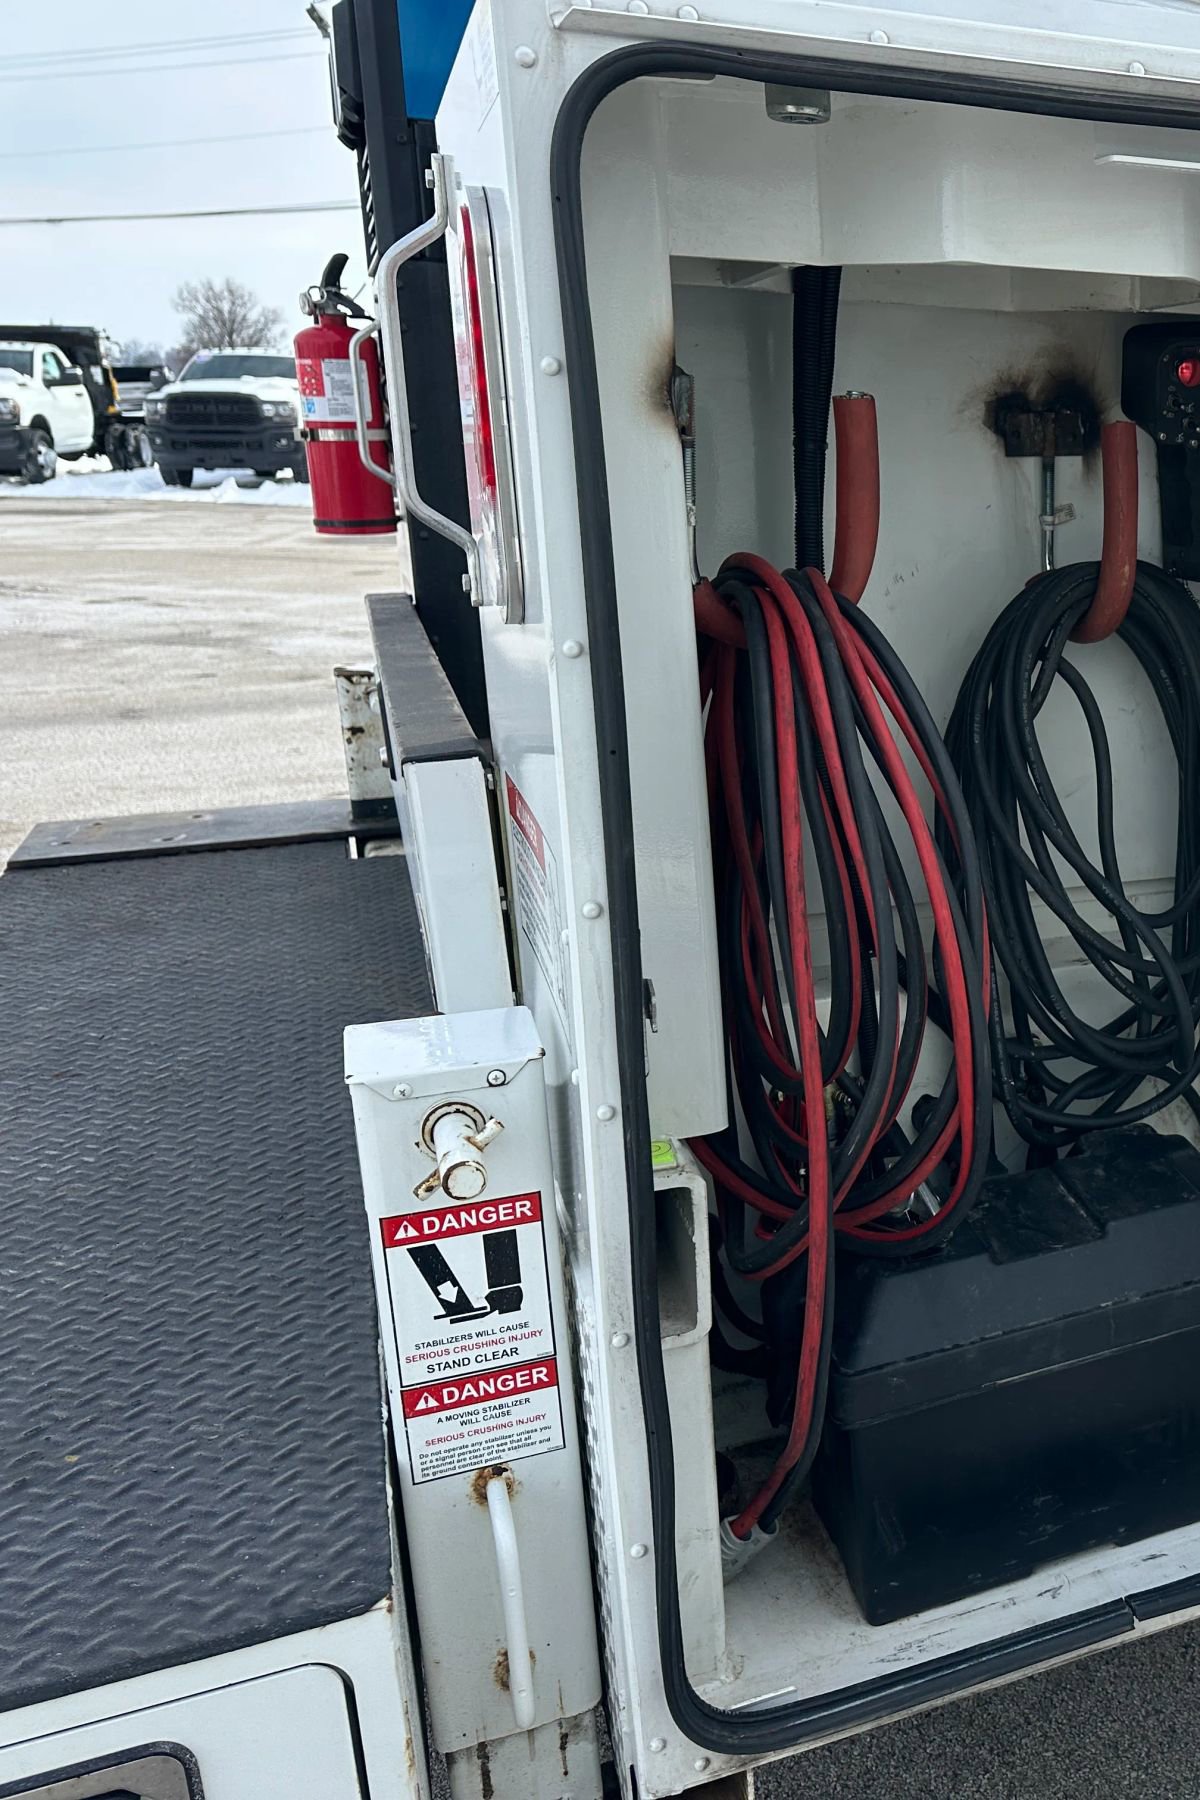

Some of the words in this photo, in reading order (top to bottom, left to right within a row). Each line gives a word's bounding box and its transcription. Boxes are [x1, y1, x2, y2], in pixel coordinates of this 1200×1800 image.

[422, 1200, 533, 1234] DANGER
[405, 1348, 450, 1363] SERIOUS
[452, 1337, 505, 1353] CRUSHING
[508, 1329, 543, 1342] INJURY
[414, 1332, 473, 1350] STABILIZERS
[474, 1328, 497, 1338] WILL
[498, 1321, 529, 1333] CAUSE
[426, 1357, 470, 1373] STAND
[474, 1346, 519, 1363] CLEAR
[442, 1366, 549, 1404] DANGER
[445, 1408, 480, 1422] MOVING
[481, 1397, 530, 1413] STABILIZER
[459, 1417, 481, 1426] WILL
[482, 1409, 512, 1421] CAUSE
[425, 1432, 465, 1446] SERIOUS
[467, 1420, 513, 1437] CRUSHING
[515, 1413, 546, 1425] INJURY
